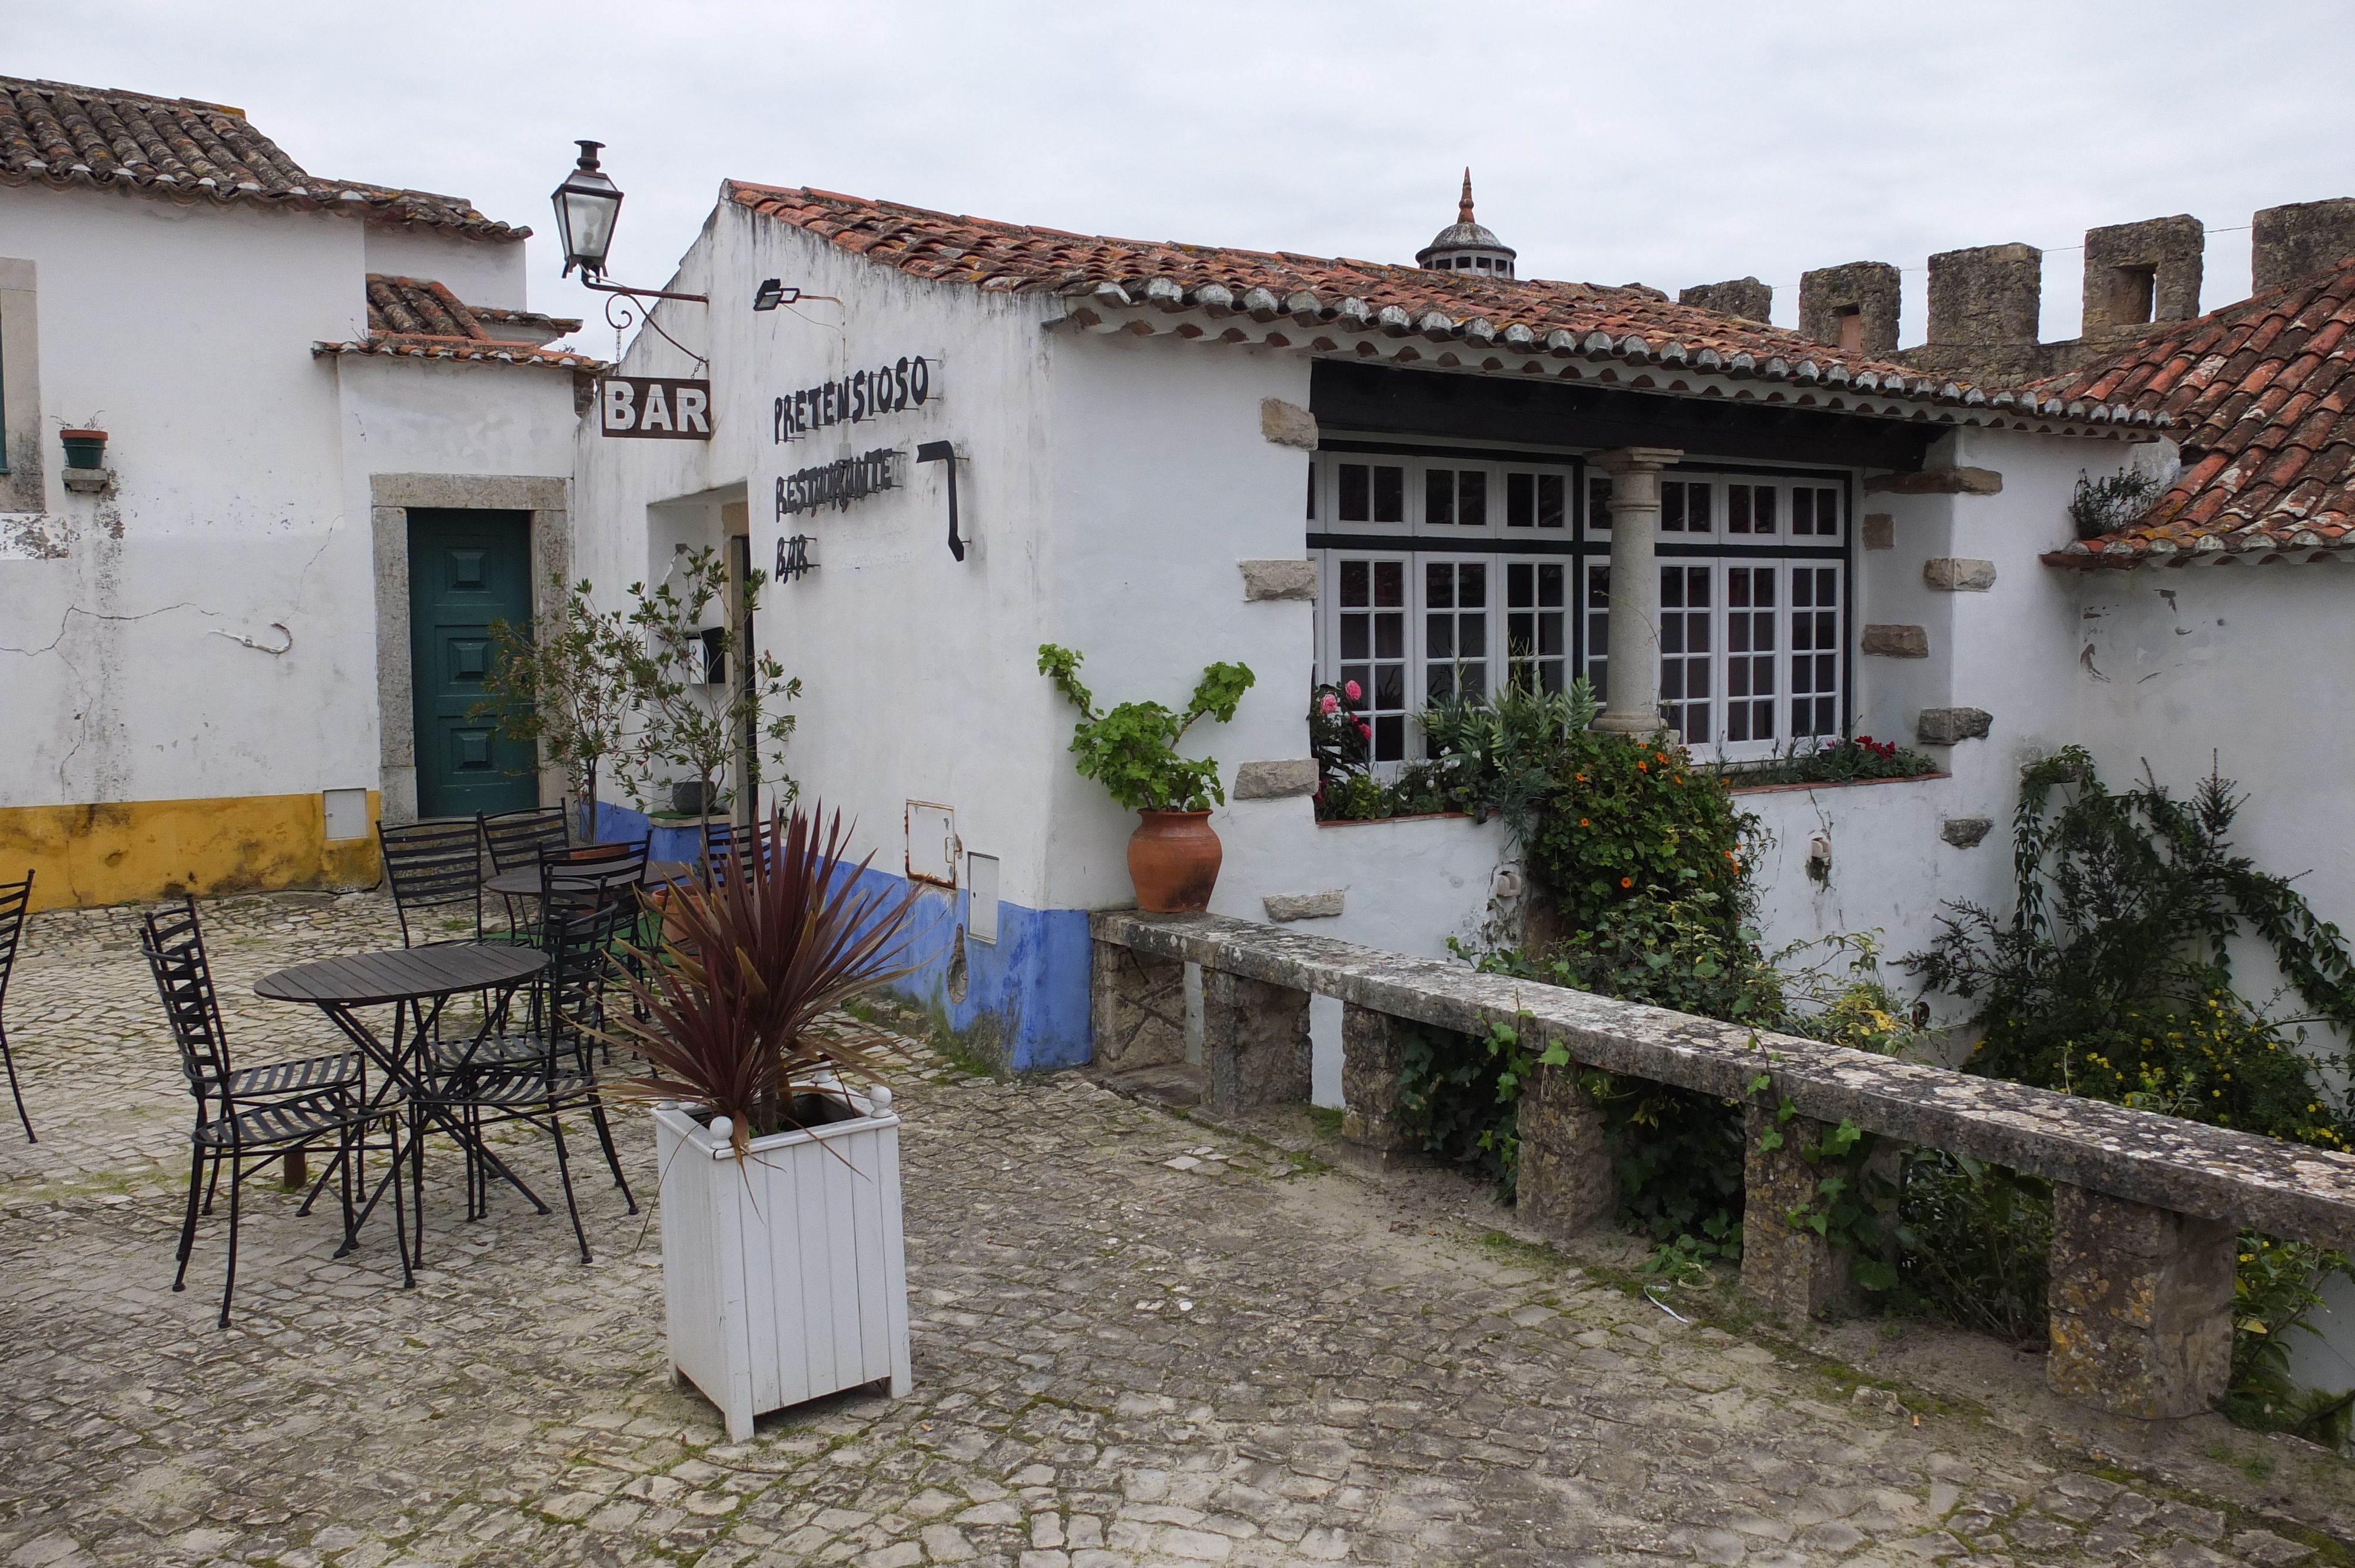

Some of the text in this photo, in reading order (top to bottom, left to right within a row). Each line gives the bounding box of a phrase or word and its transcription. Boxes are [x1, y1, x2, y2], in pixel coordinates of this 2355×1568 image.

[605, 381, 709, 433] BAR
[775, 356, 928, 445] PRETENSIOSO
[776, 448, 893, 523] RESTAURANTE
[775, 534, 807, 584] BAR
